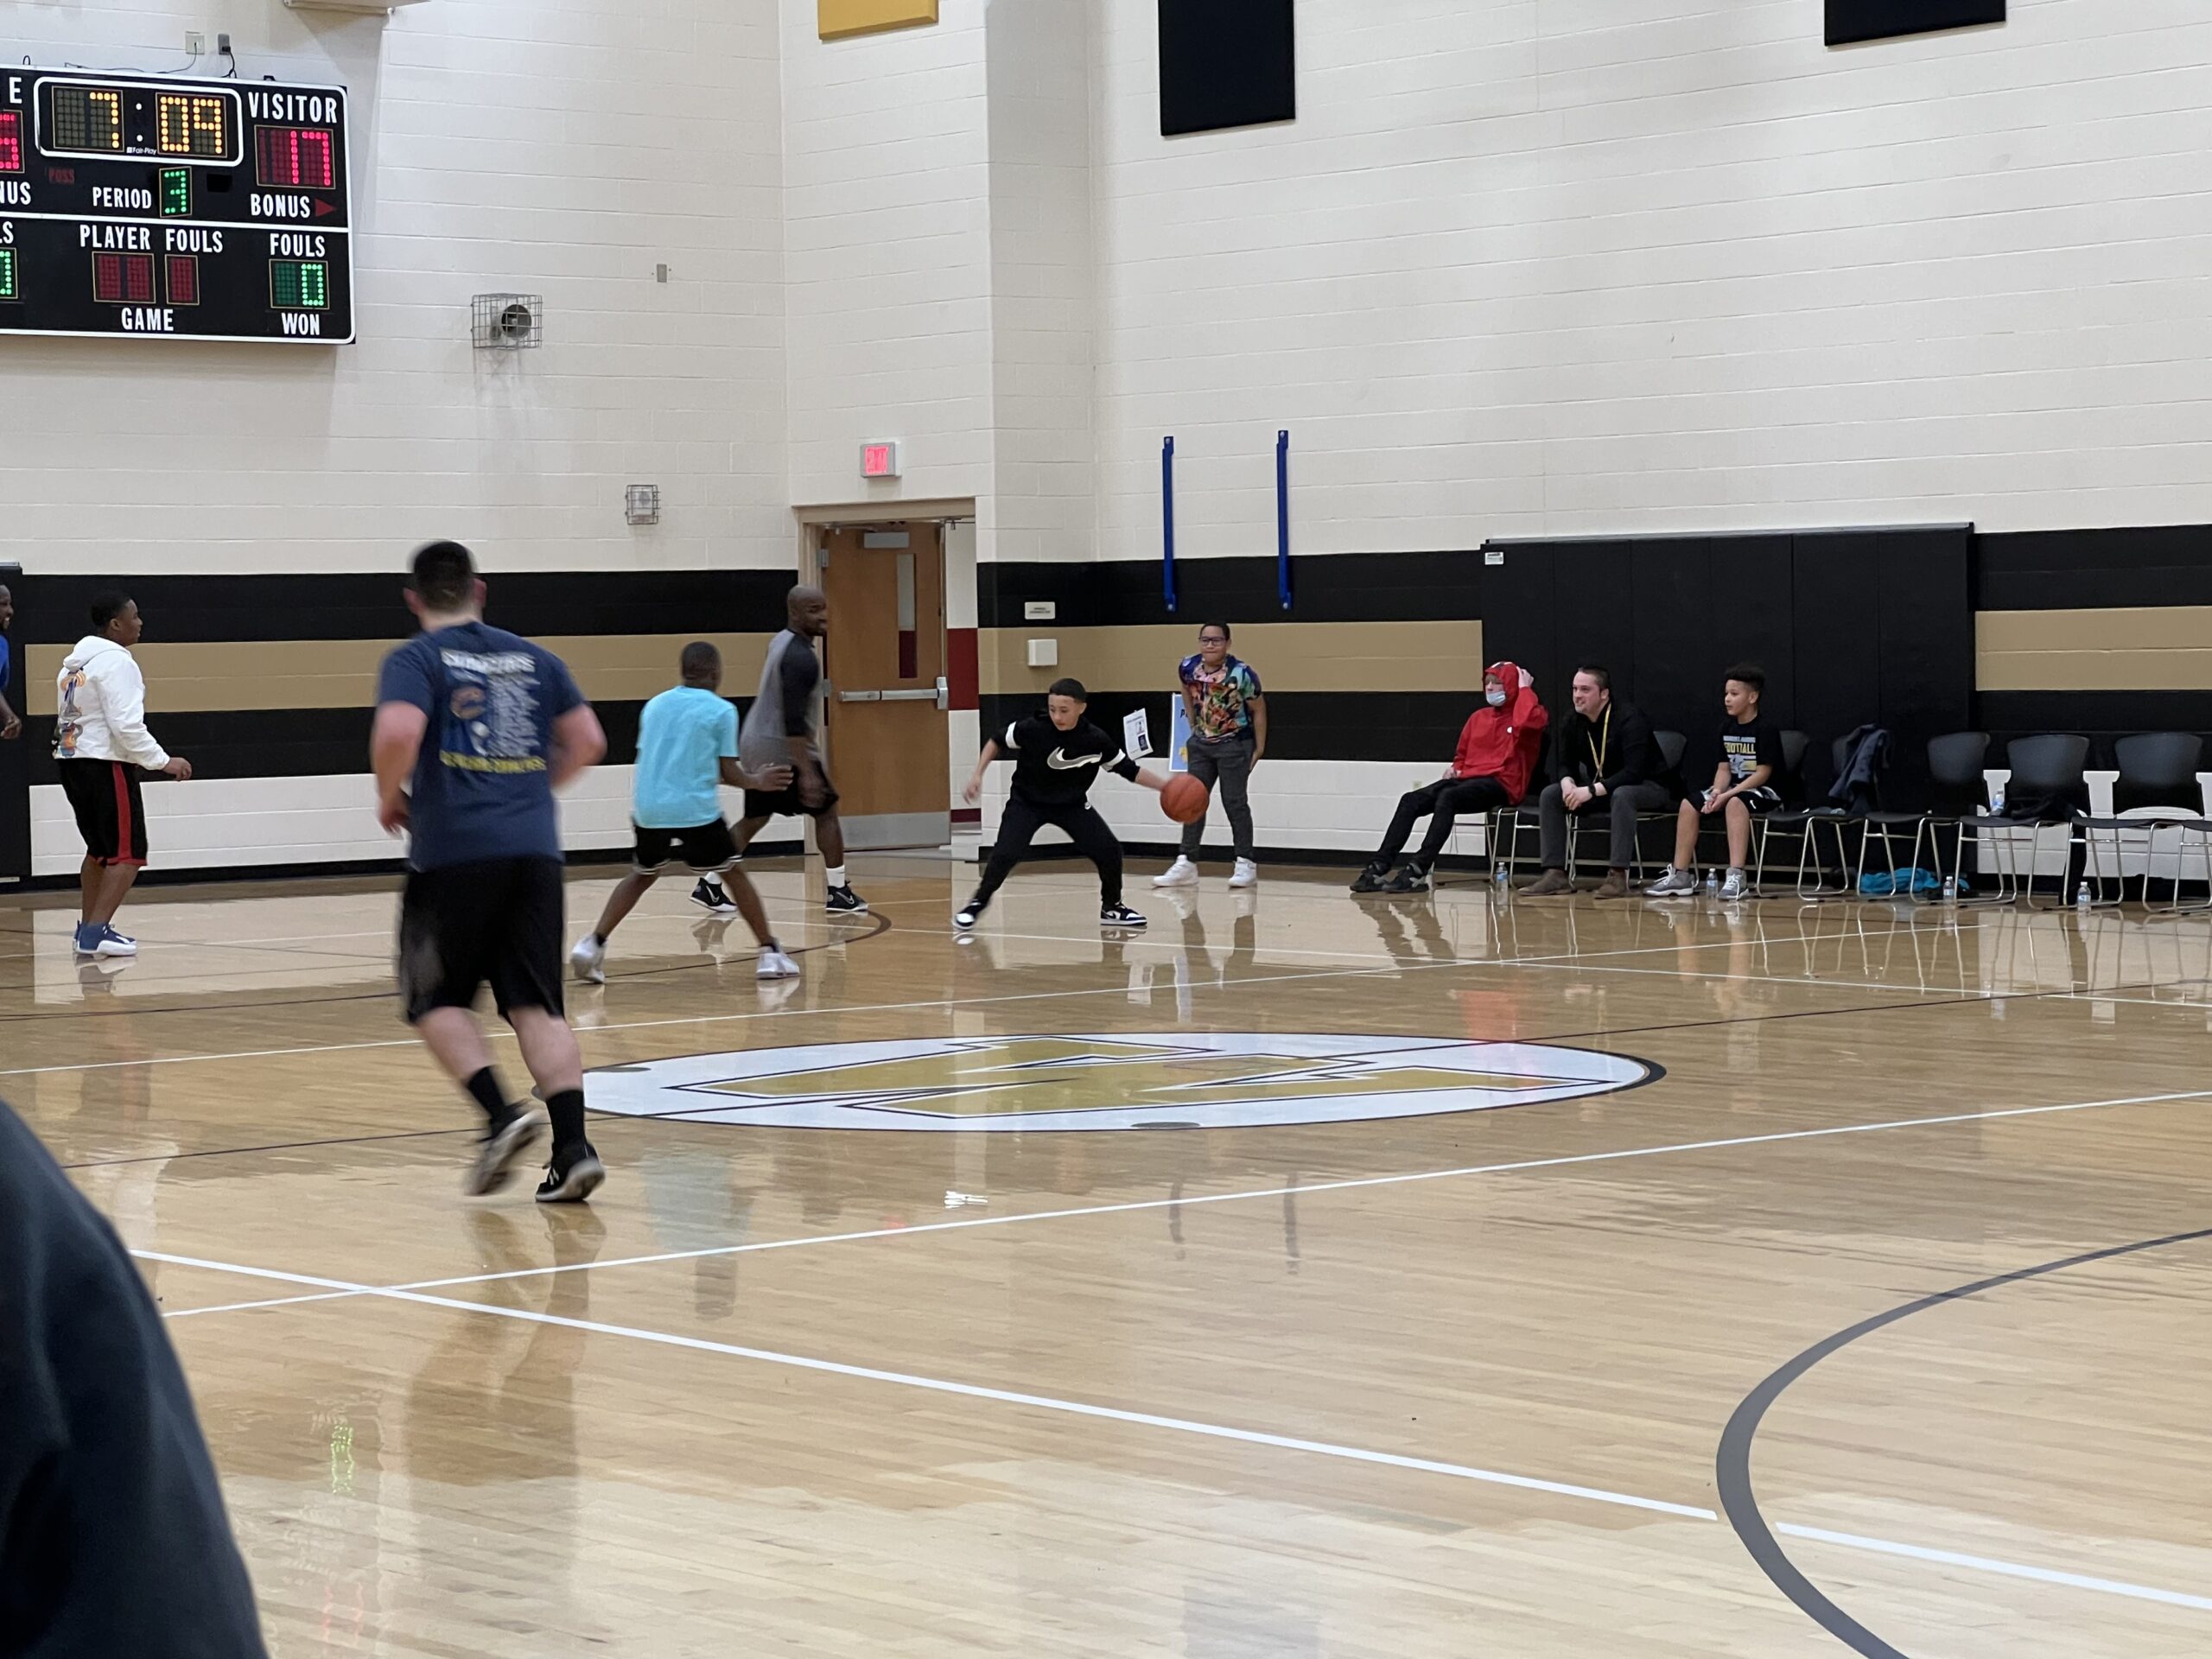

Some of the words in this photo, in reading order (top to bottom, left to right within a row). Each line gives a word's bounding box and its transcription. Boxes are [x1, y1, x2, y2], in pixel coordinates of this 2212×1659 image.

[248, 92, 338, 124] VISITOR
[290, 130, 331, 187] 17
[92, 187, 152, 209] PERIOD
[164, 170, 187, 213] 3
[250, 194, 311, 218] BONUS
[79, 225, 151, 251] PLAYER
[165, 228, 224, 253] FOULS
[270, 232, 327, 257] FOULS
[301, 264, 325, 306] 0
[121, 308, 175, 332] GAME
[281, 312, 321, 336] WON
